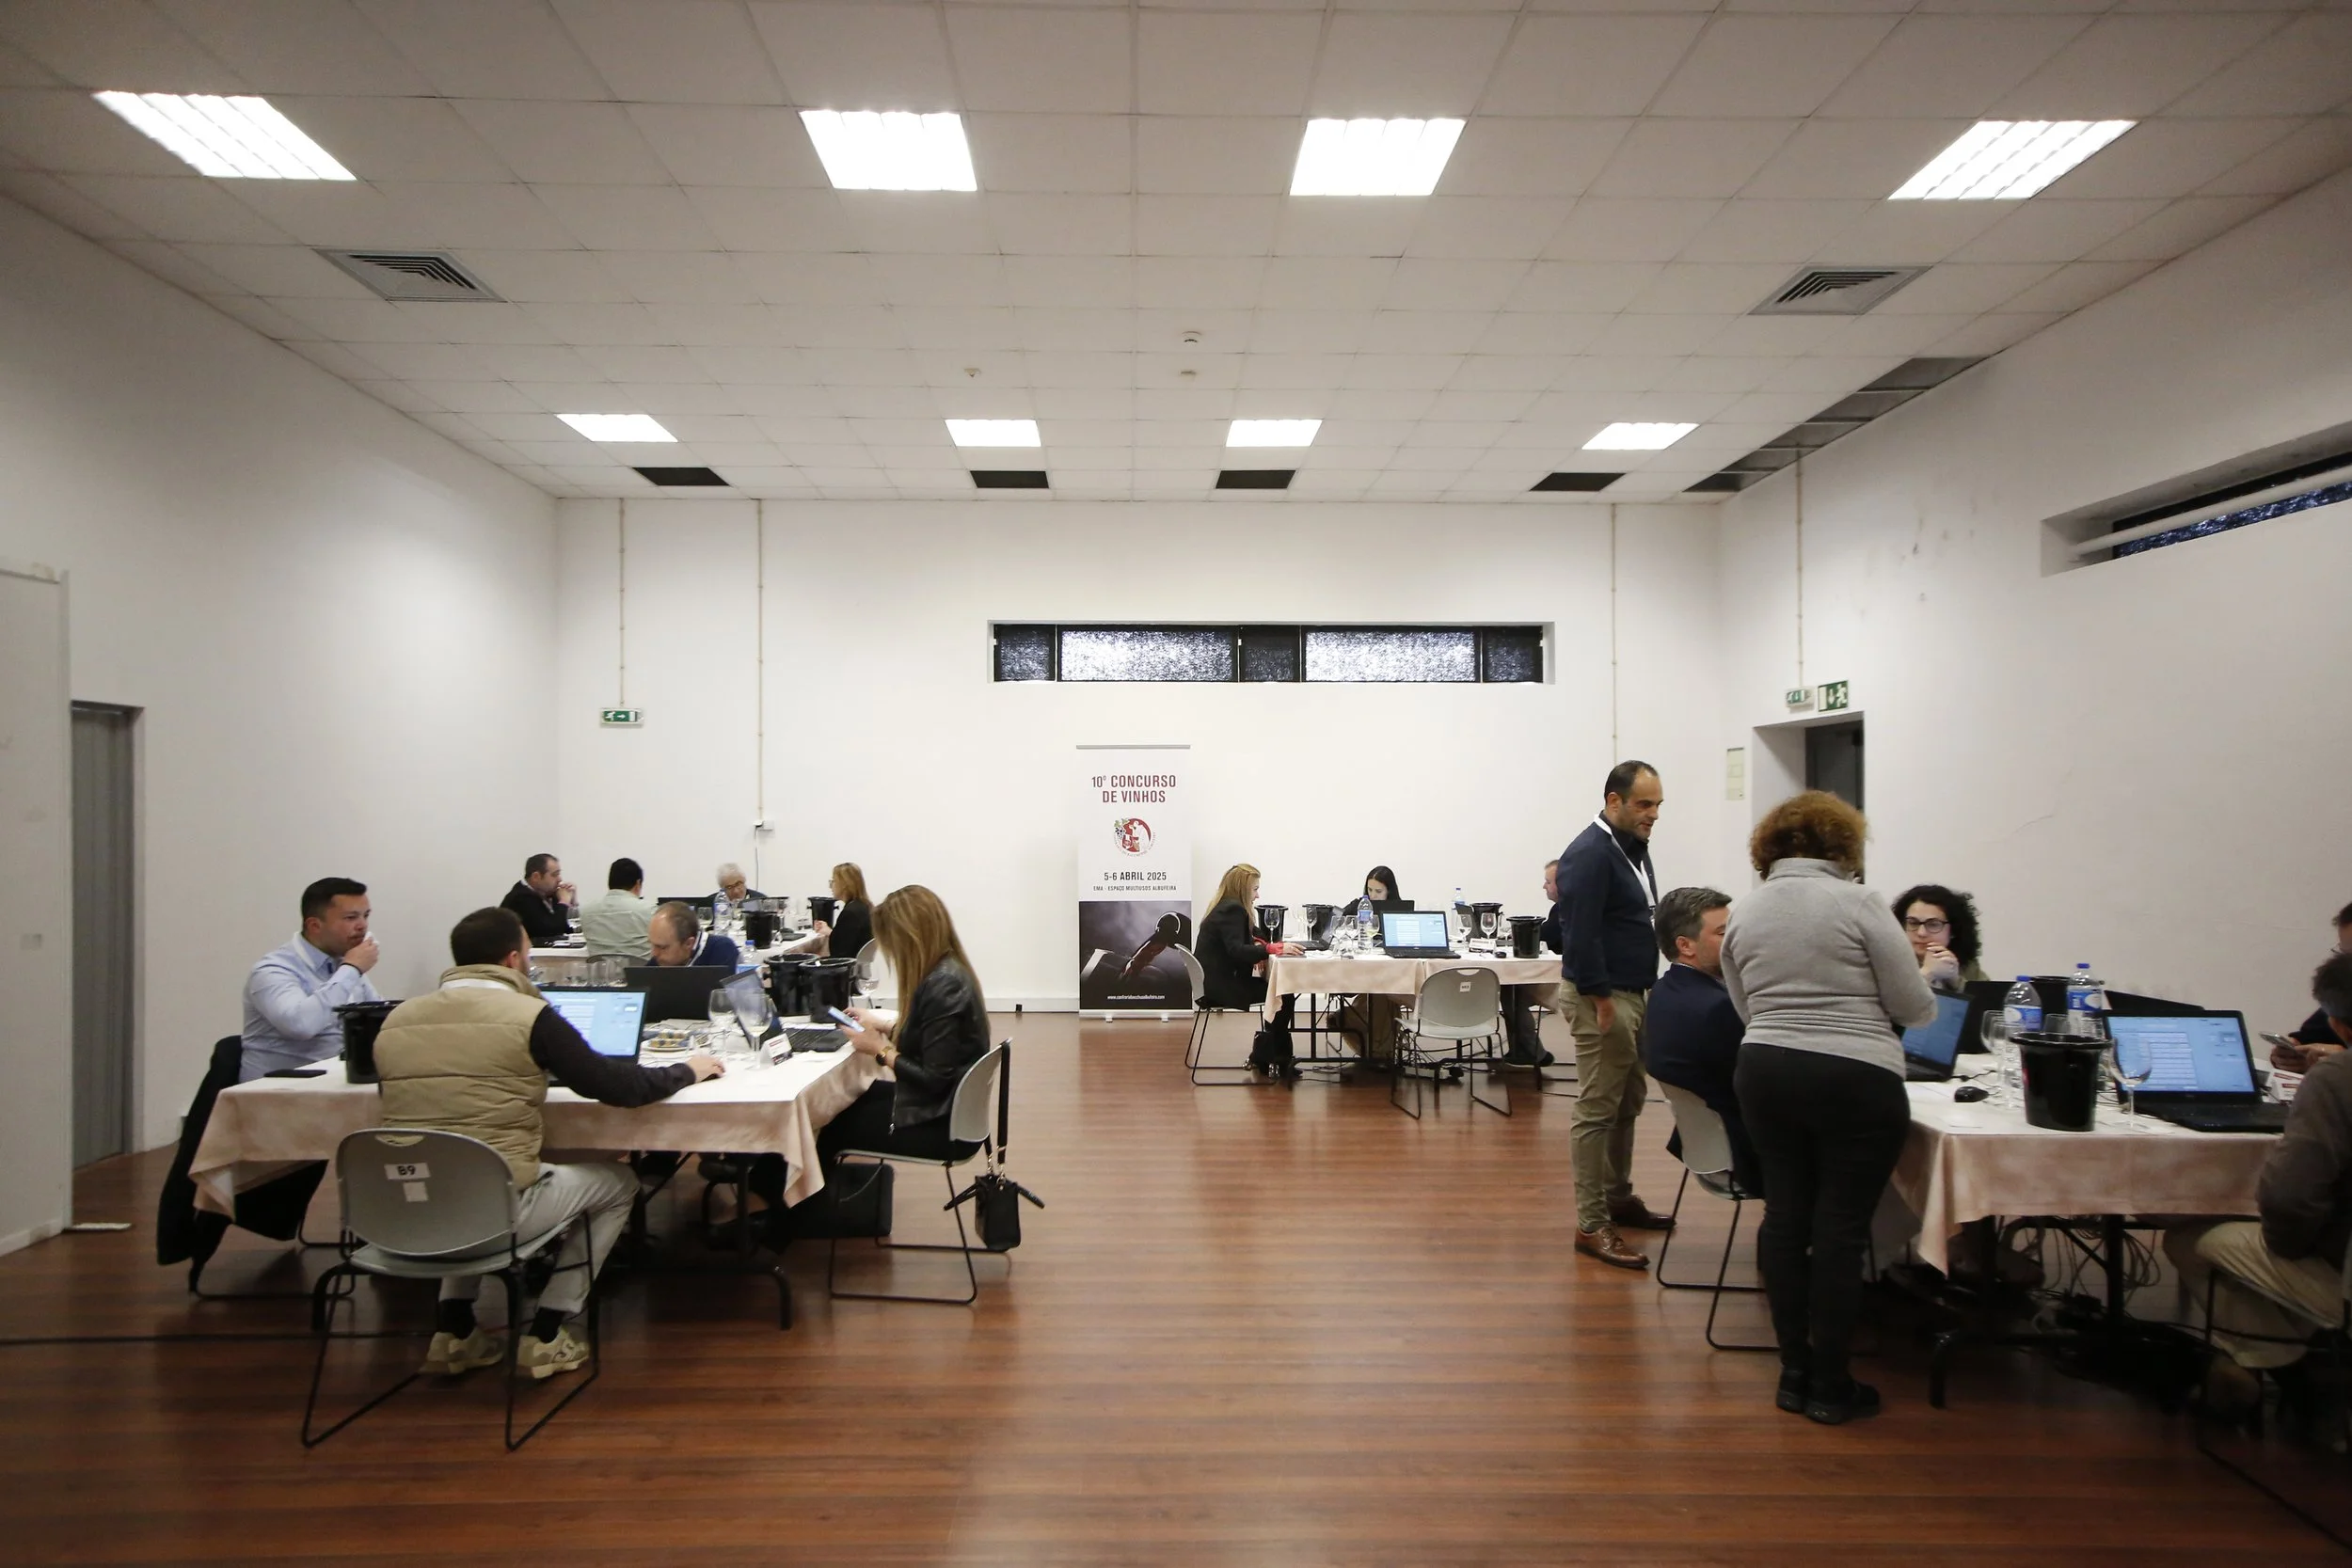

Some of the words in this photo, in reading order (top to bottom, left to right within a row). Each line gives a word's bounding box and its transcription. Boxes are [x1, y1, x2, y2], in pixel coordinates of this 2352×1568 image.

[1110, 774, 1177, 788] CONCURSO
[1102, 790, 1118, 803] DE
[1120, 790, 1166, 803] VINHOS
[1104, 872, 1118, 881] 5-6
[1120, 871, 1145, 880] ABRIL
[1147, 871, 1168, 881] 2025
[397, 1165, 416, 1176] B9
